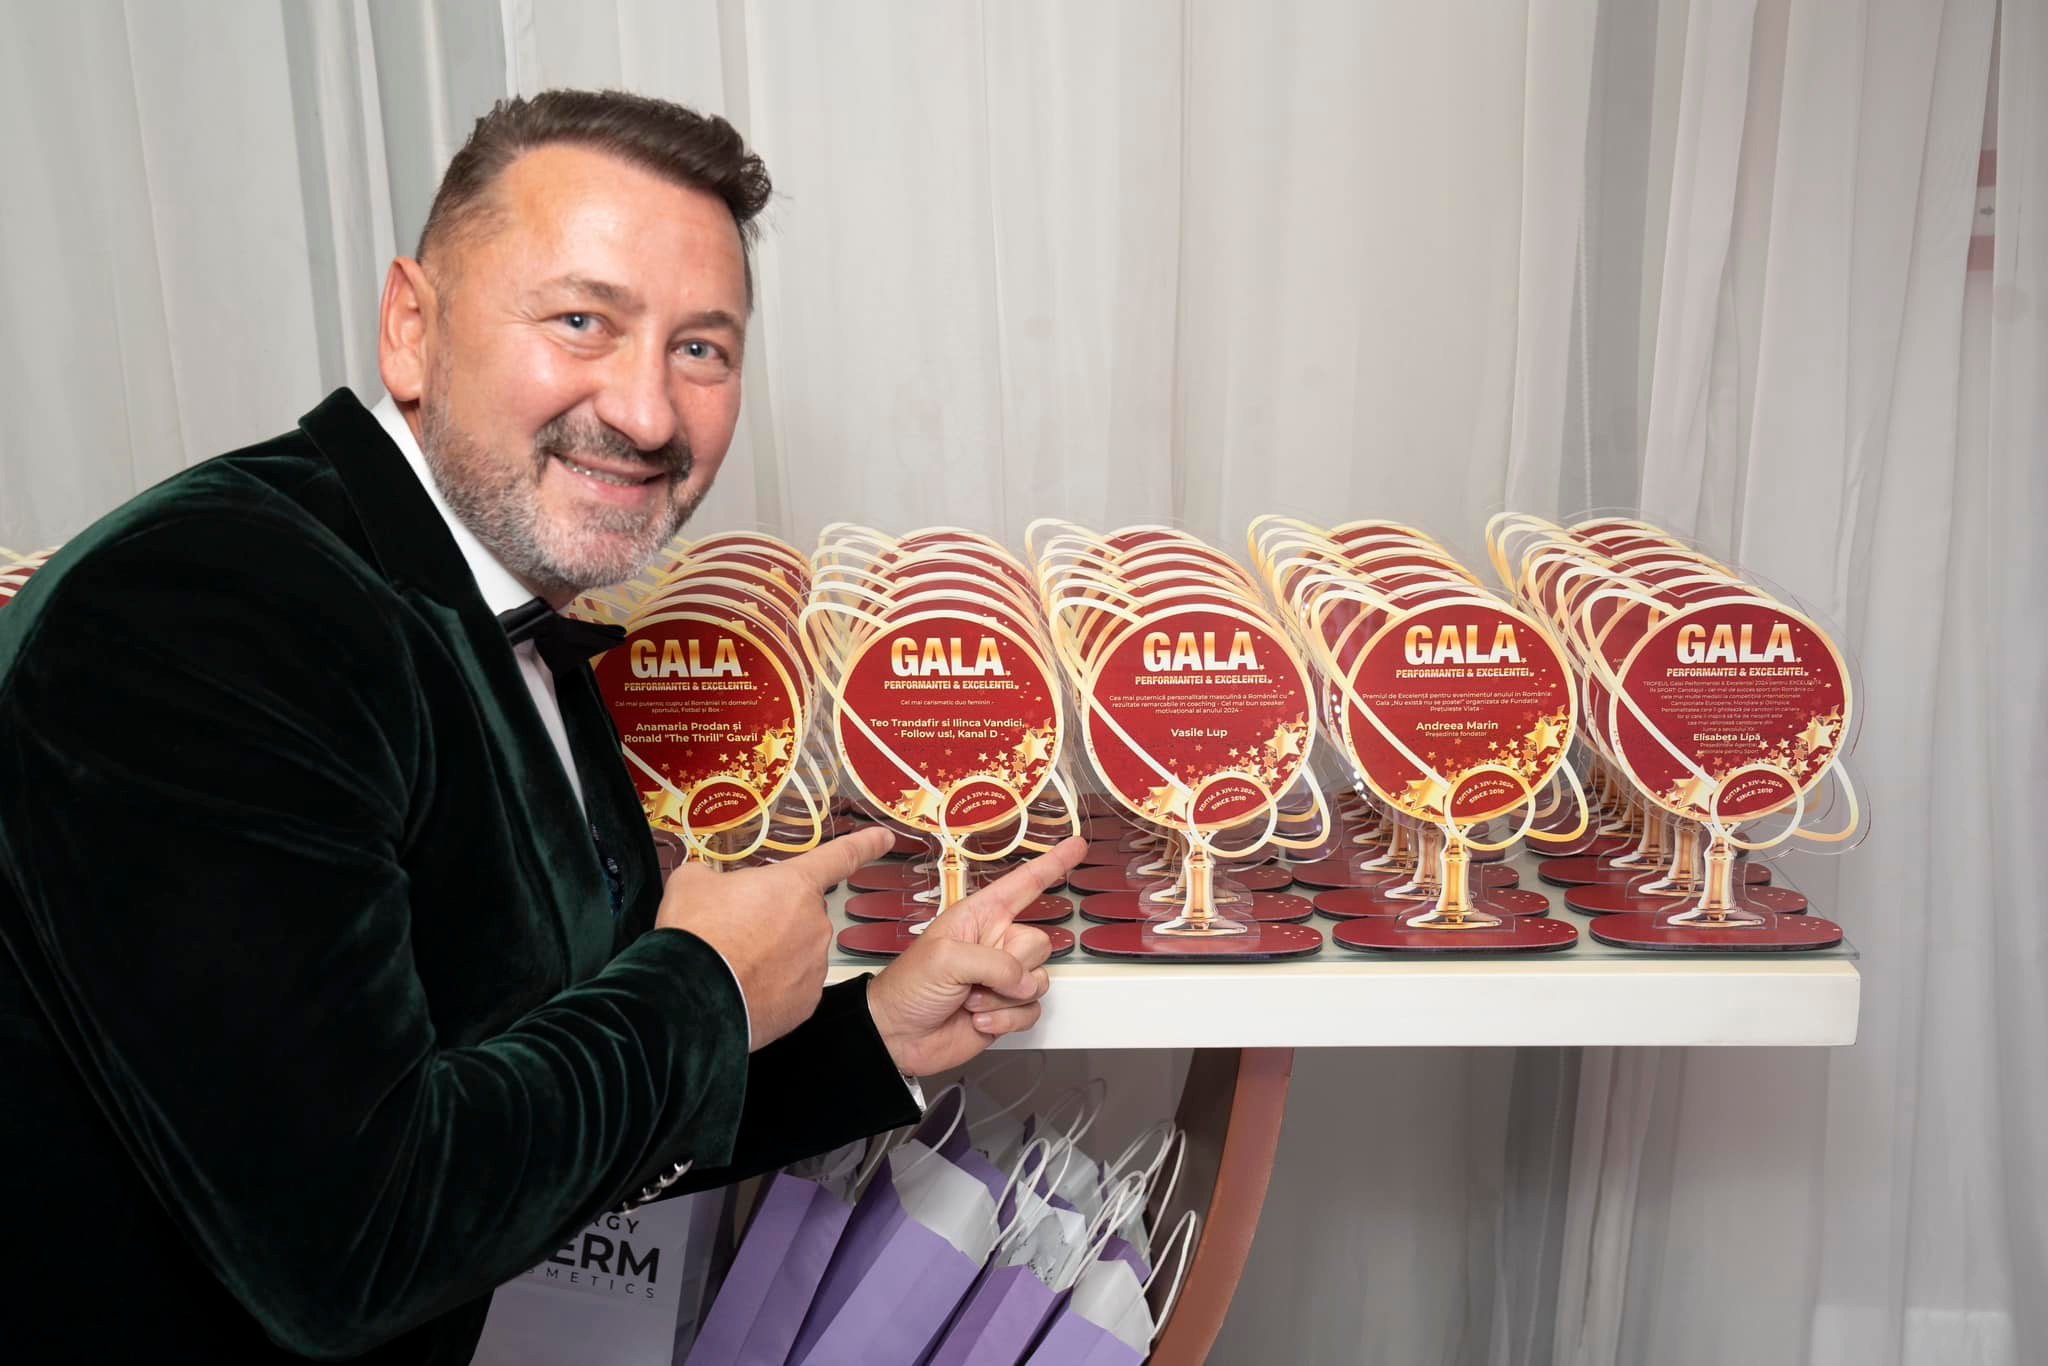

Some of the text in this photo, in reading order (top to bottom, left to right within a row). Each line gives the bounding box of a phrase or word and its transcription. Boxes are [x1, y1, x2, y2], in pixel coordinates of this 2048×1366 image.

[1404, 624, 1521, 665] GALA
[1676, 623, 1795, 664] GALA
[1143, 631, 1258, 672] GALA
[631, 638, 742, 678] GALA
[891, 637, 1005, 677] GALA
[1467, 669, 1474, 678] &
[1739, 668, 1747, 677] &
[1205, 675, 1213, 685] &
[692, 682, 699, 690] &
[953, 681, 960, 690] &
[1167, 694, 1208, 702] personalitate
[636, 721, 741, 733] Anamaria Prodan și
[870, 719, 889, 727] Teo
[891, 718, 939, 727] Trandafir
[953, 718, 981, 727] Ilinca
[983, 718, 1025, 728] Vandici,
[1416, 720, 1498, 731] Andreea Marin
[624, 734, 662, 743] Ronald
[664, 734, 689, 743] "The
[726, 732, 758, 742] Gavril
[901, 729, 935, 738] Follow
[958, 729, 987, 738] Kanal
[990, 730, 998, 738] D
[1170, 728, 1228, 739] Vasile Lup
[1693, 732, 1760, 742] Elisabeta Lipă
[1240, 787, 1256, 796] 2024
[1211, 797, 1230, 810] SINCE
